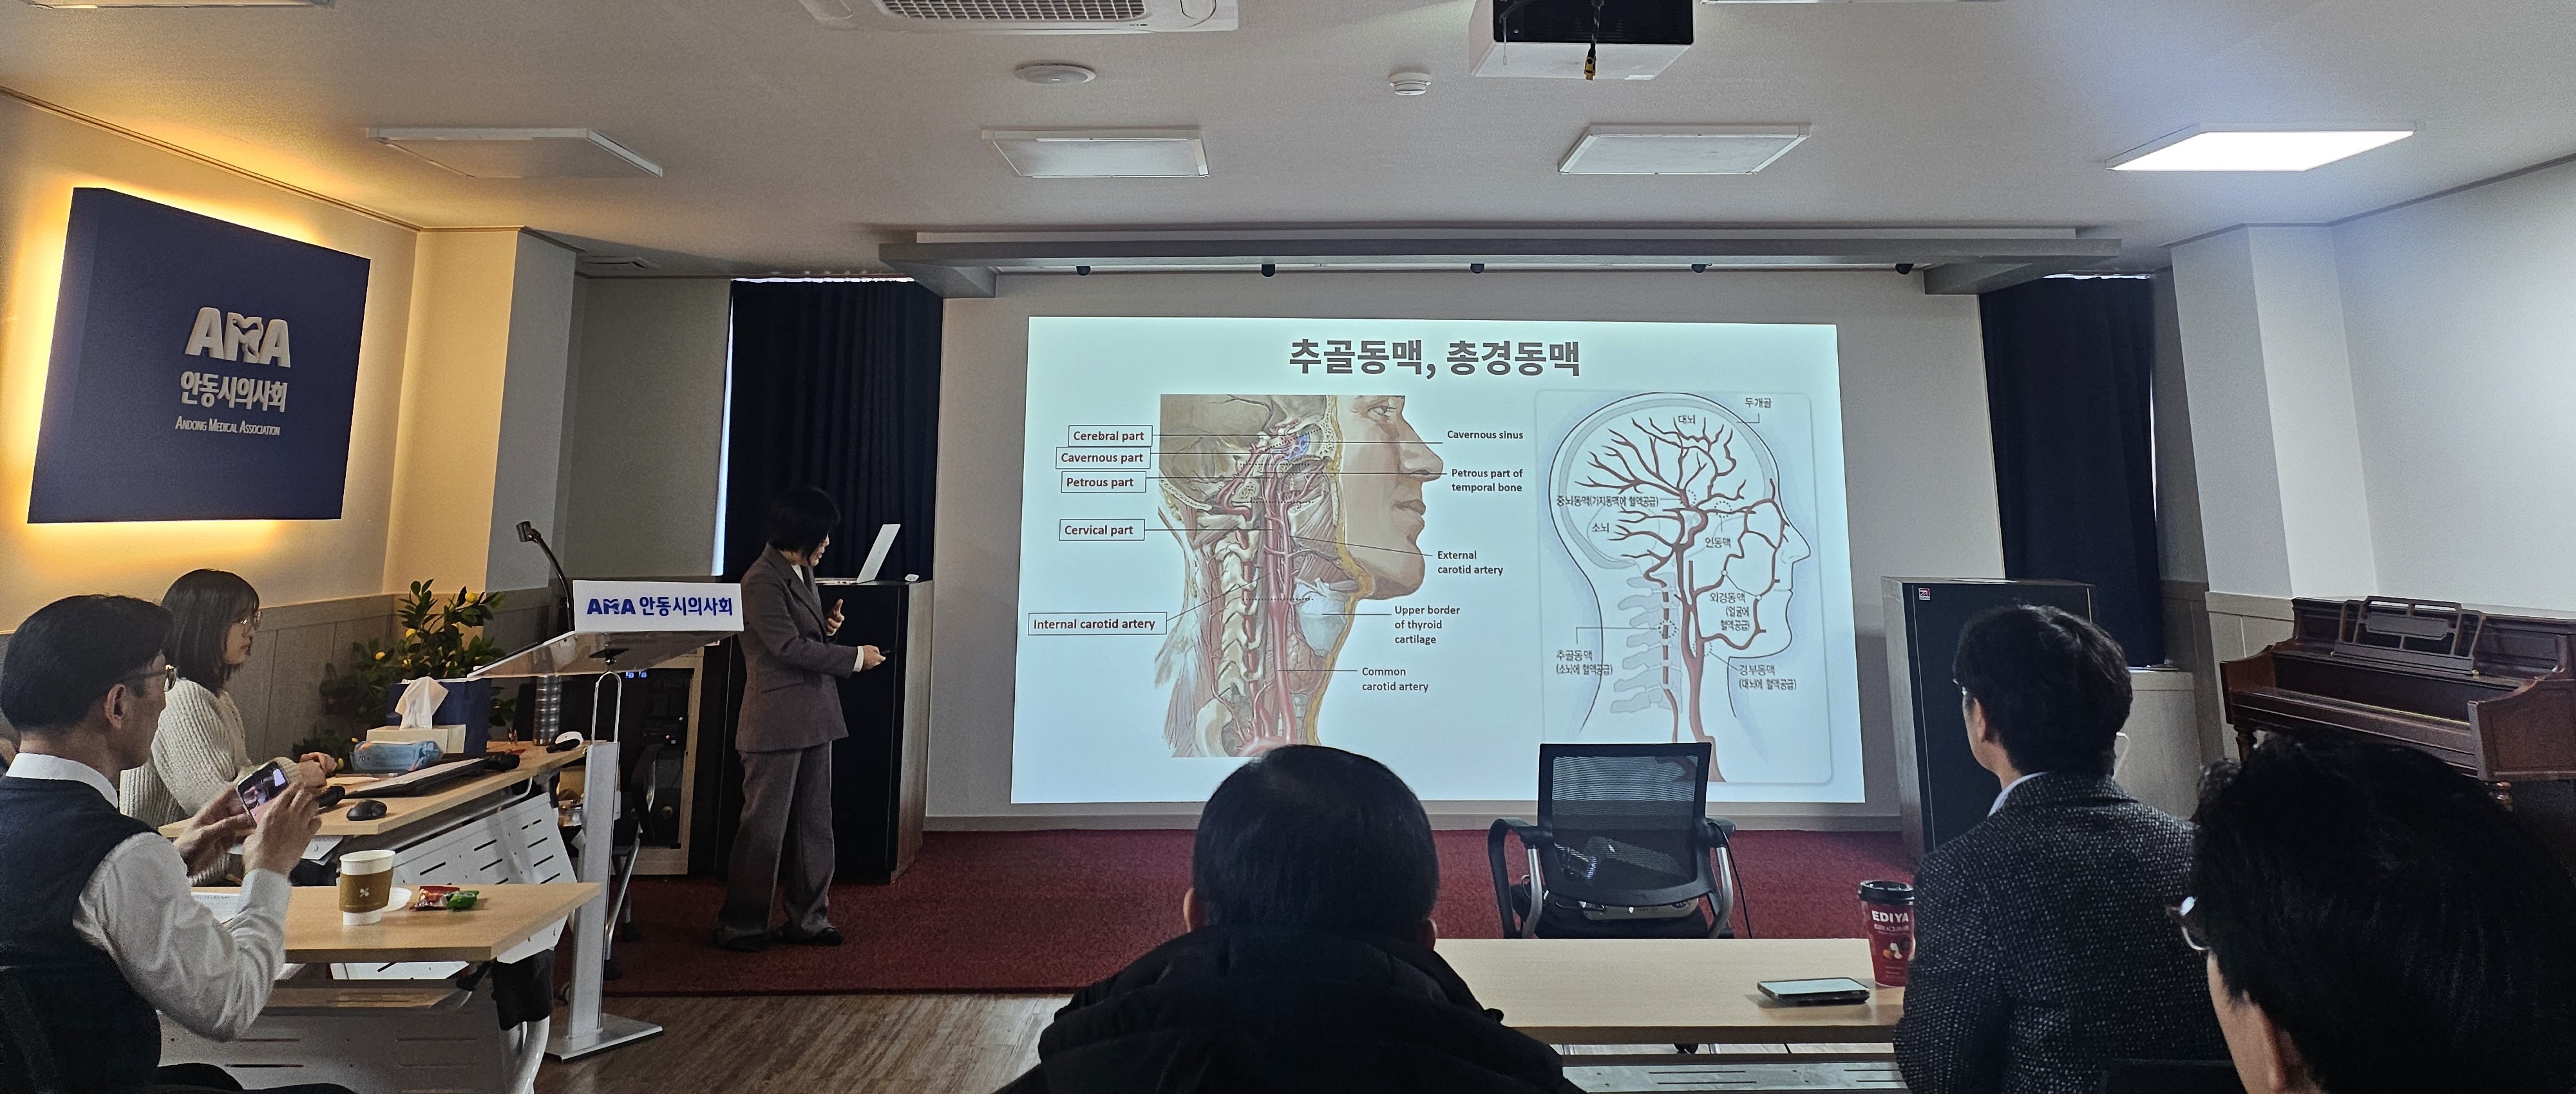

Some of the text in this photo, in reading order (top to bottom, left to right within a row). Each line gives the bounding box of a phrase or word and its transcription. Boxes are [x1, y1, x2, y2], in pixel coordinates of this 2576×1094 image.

[185, 307, 291, 368] AMA
[1290, 339, 1580, 379] 추골동맥, 총경동맥
[180, 371, 288, 413] 안동시의사회
[1745, 397, 1772, 408] 두개골
[1678, 415, 1696, 425] 대뇌
[1074, 431, 1144, 443] Cerebral part
[1447, 430, 1524, 439] Cavernous sinus
[1061, 453, 1144, 465] Cavernous part
[1452, 469, 1524, 480] Petrous part of
[1067, 478, 1134, 489] Petrous part
[1452, 483, 1522, 493] temporal bone
[1065, 525, 1133, 537] Cervical part
[1592, 523, 1609, 533] 소뇌
[1437, 550, 1477, 560] External
[1437, 564, 1504, 576] carotid artery
[1710, 592, 1745, 603] 외경동맥
[587, 597, 733, 617] AMA 안동시의사회
[1394, 605, 1461, 616] Upper border
[1034, 619, 1155, 631] Internal carotid artery
[1394, 620, 1443, 631] of thyroid
[1394, 634, 1437, 646] cartilage
[1362, 667, 1406, 677] Common
[1739, 665, 1776, 676] 경부동맥
[1362, 681, 1429, 693] carotid artery
[1871, 910, 1909, 923] EDIYA
